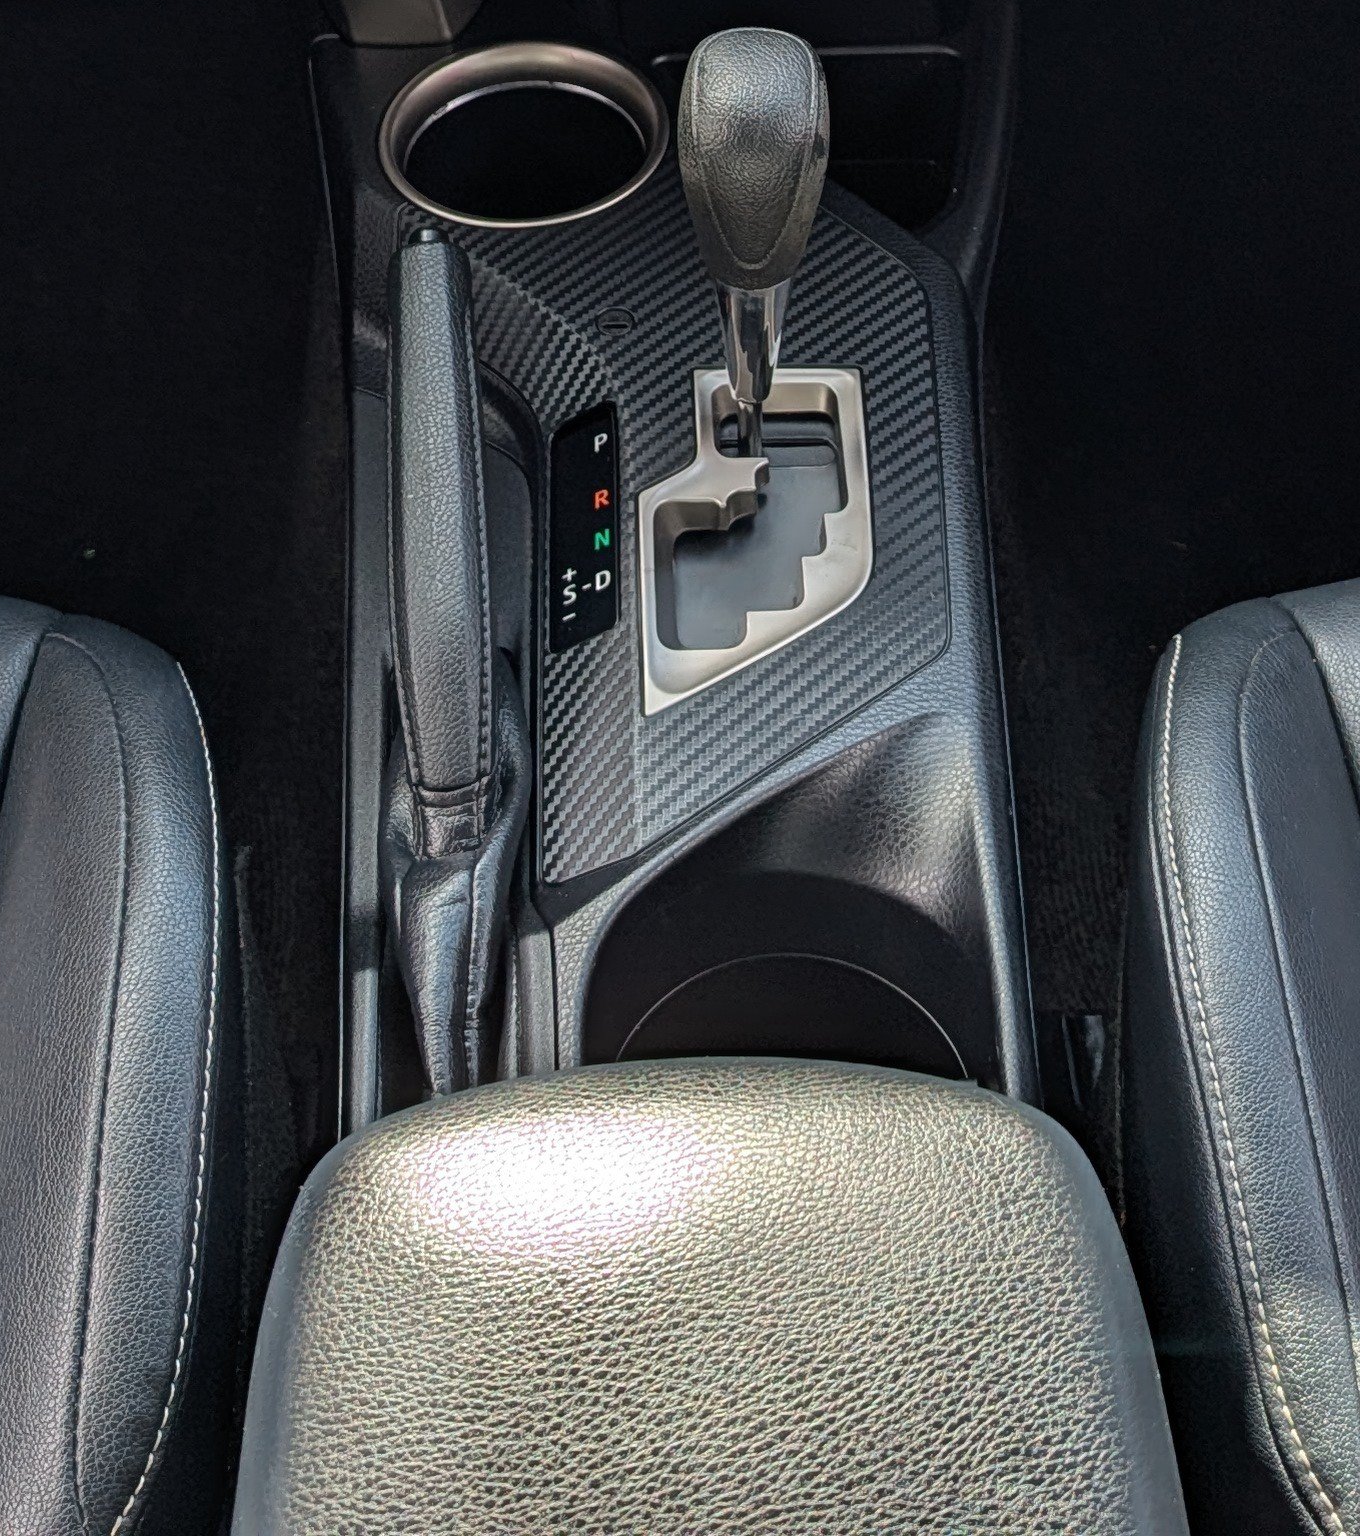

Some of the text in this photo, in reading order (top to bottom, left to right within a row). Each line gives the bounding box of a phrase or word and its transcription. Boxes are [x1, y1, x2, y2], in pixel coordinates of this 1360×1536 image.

[594, 432, 609, 454] P
[594, 488, 610, 510] R
[594, 528, 611, 551] N
